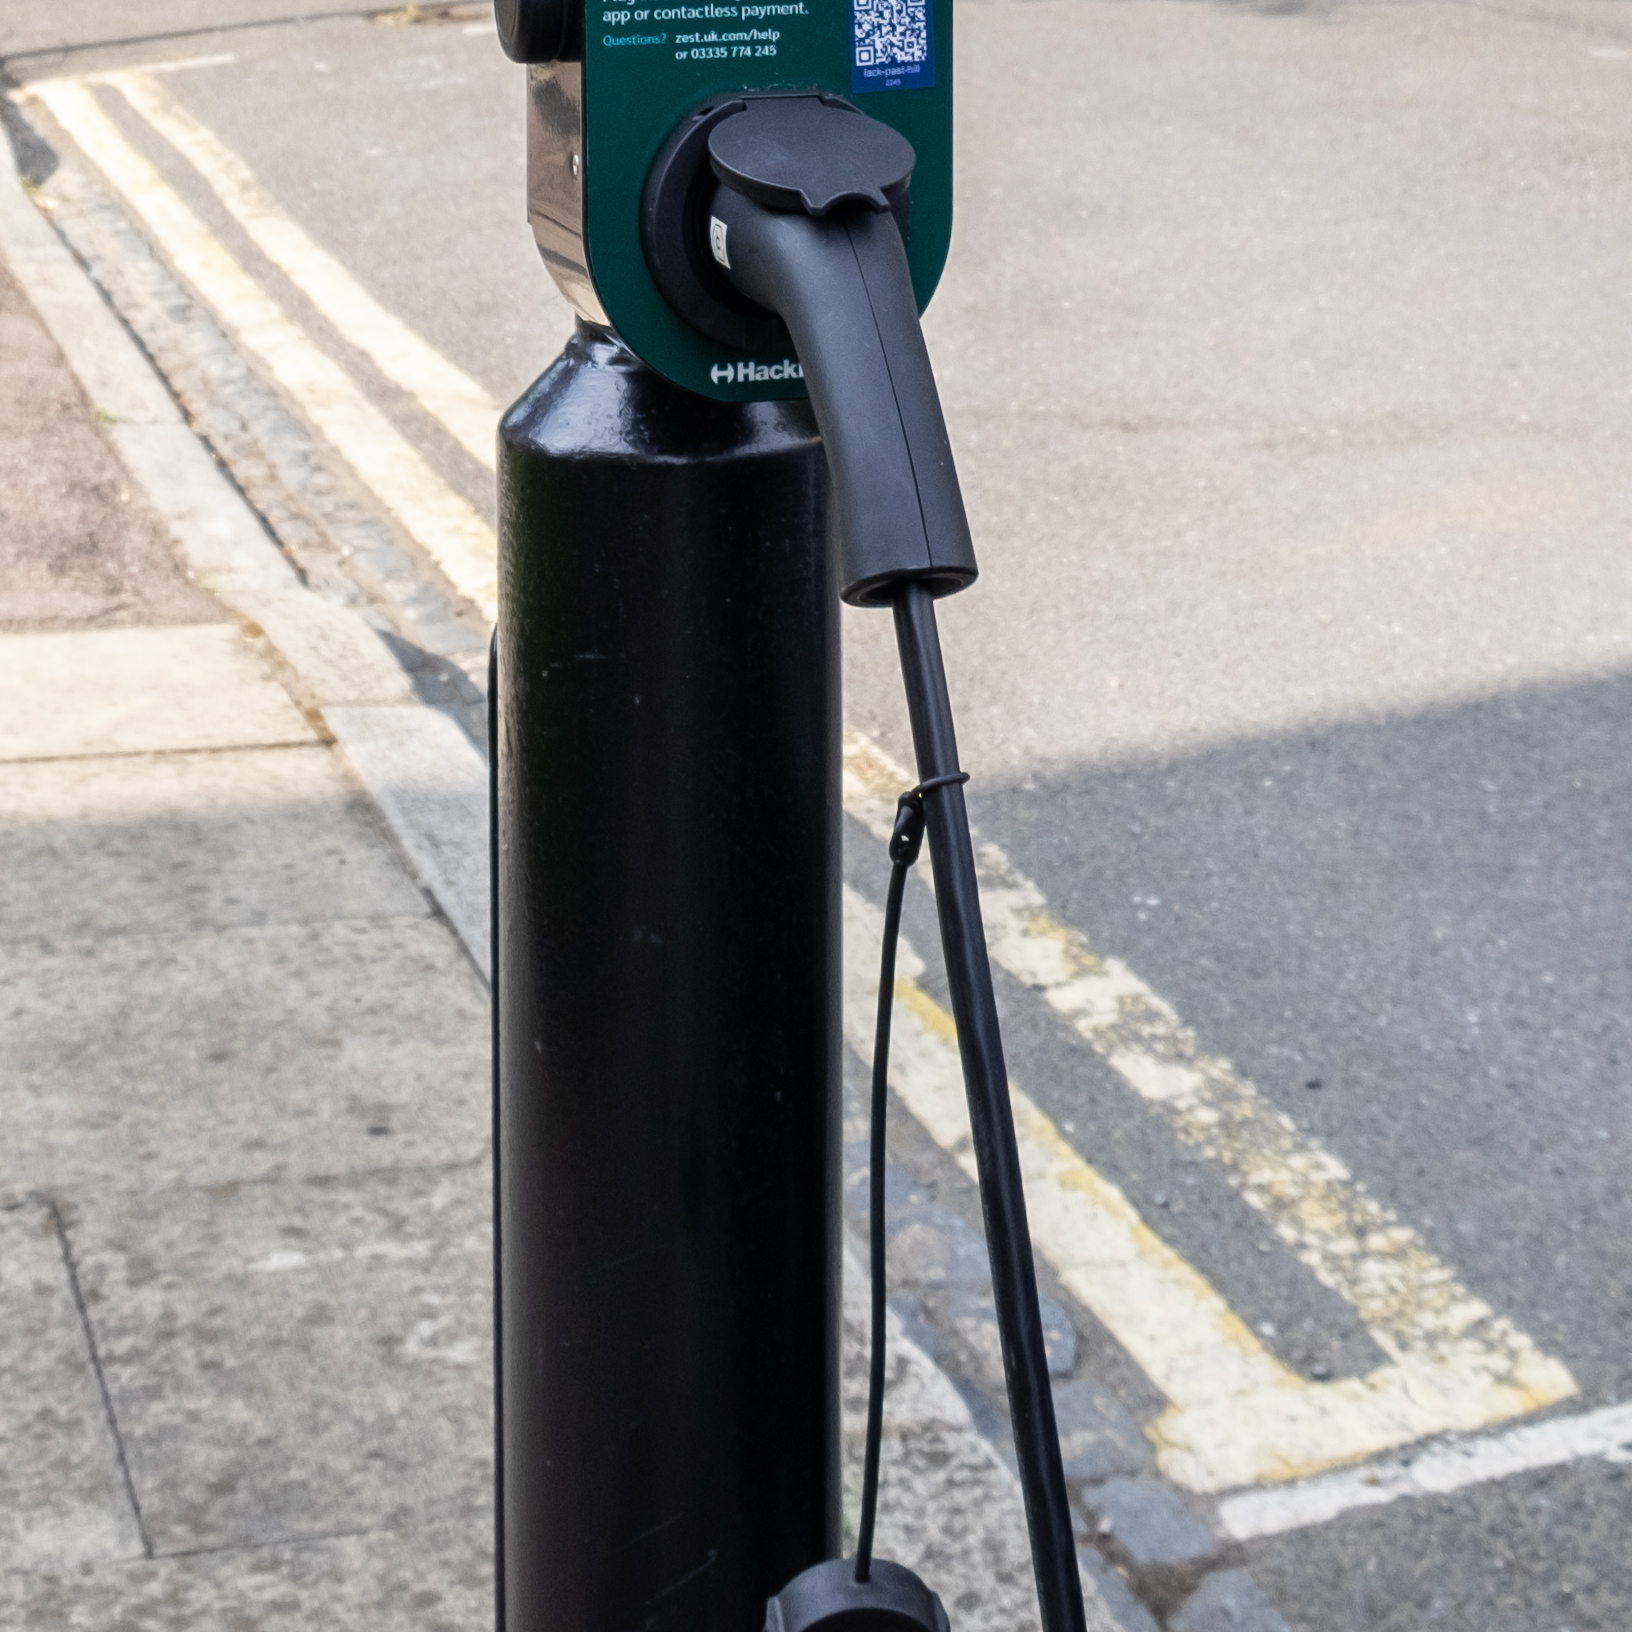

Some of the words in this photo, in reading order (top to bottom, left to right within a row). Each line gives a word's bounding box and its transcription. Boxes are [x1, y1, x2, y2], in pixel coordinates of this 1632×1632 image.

[602, 10, 630, 26] app
[634, 8, 650, 20] or
[653, 4, 738, 19] contactless
[741, 2, 809, 20] payment.
[602, 33, 667, 47] Questions?
[675, 28, 780, 44] zest.uk.com/help
[675, 49, 688, 60] or
[691, 47, 728, 59] 03335
[731, 45, 752, 58] 774
[754, 44, 777, 57] 245
